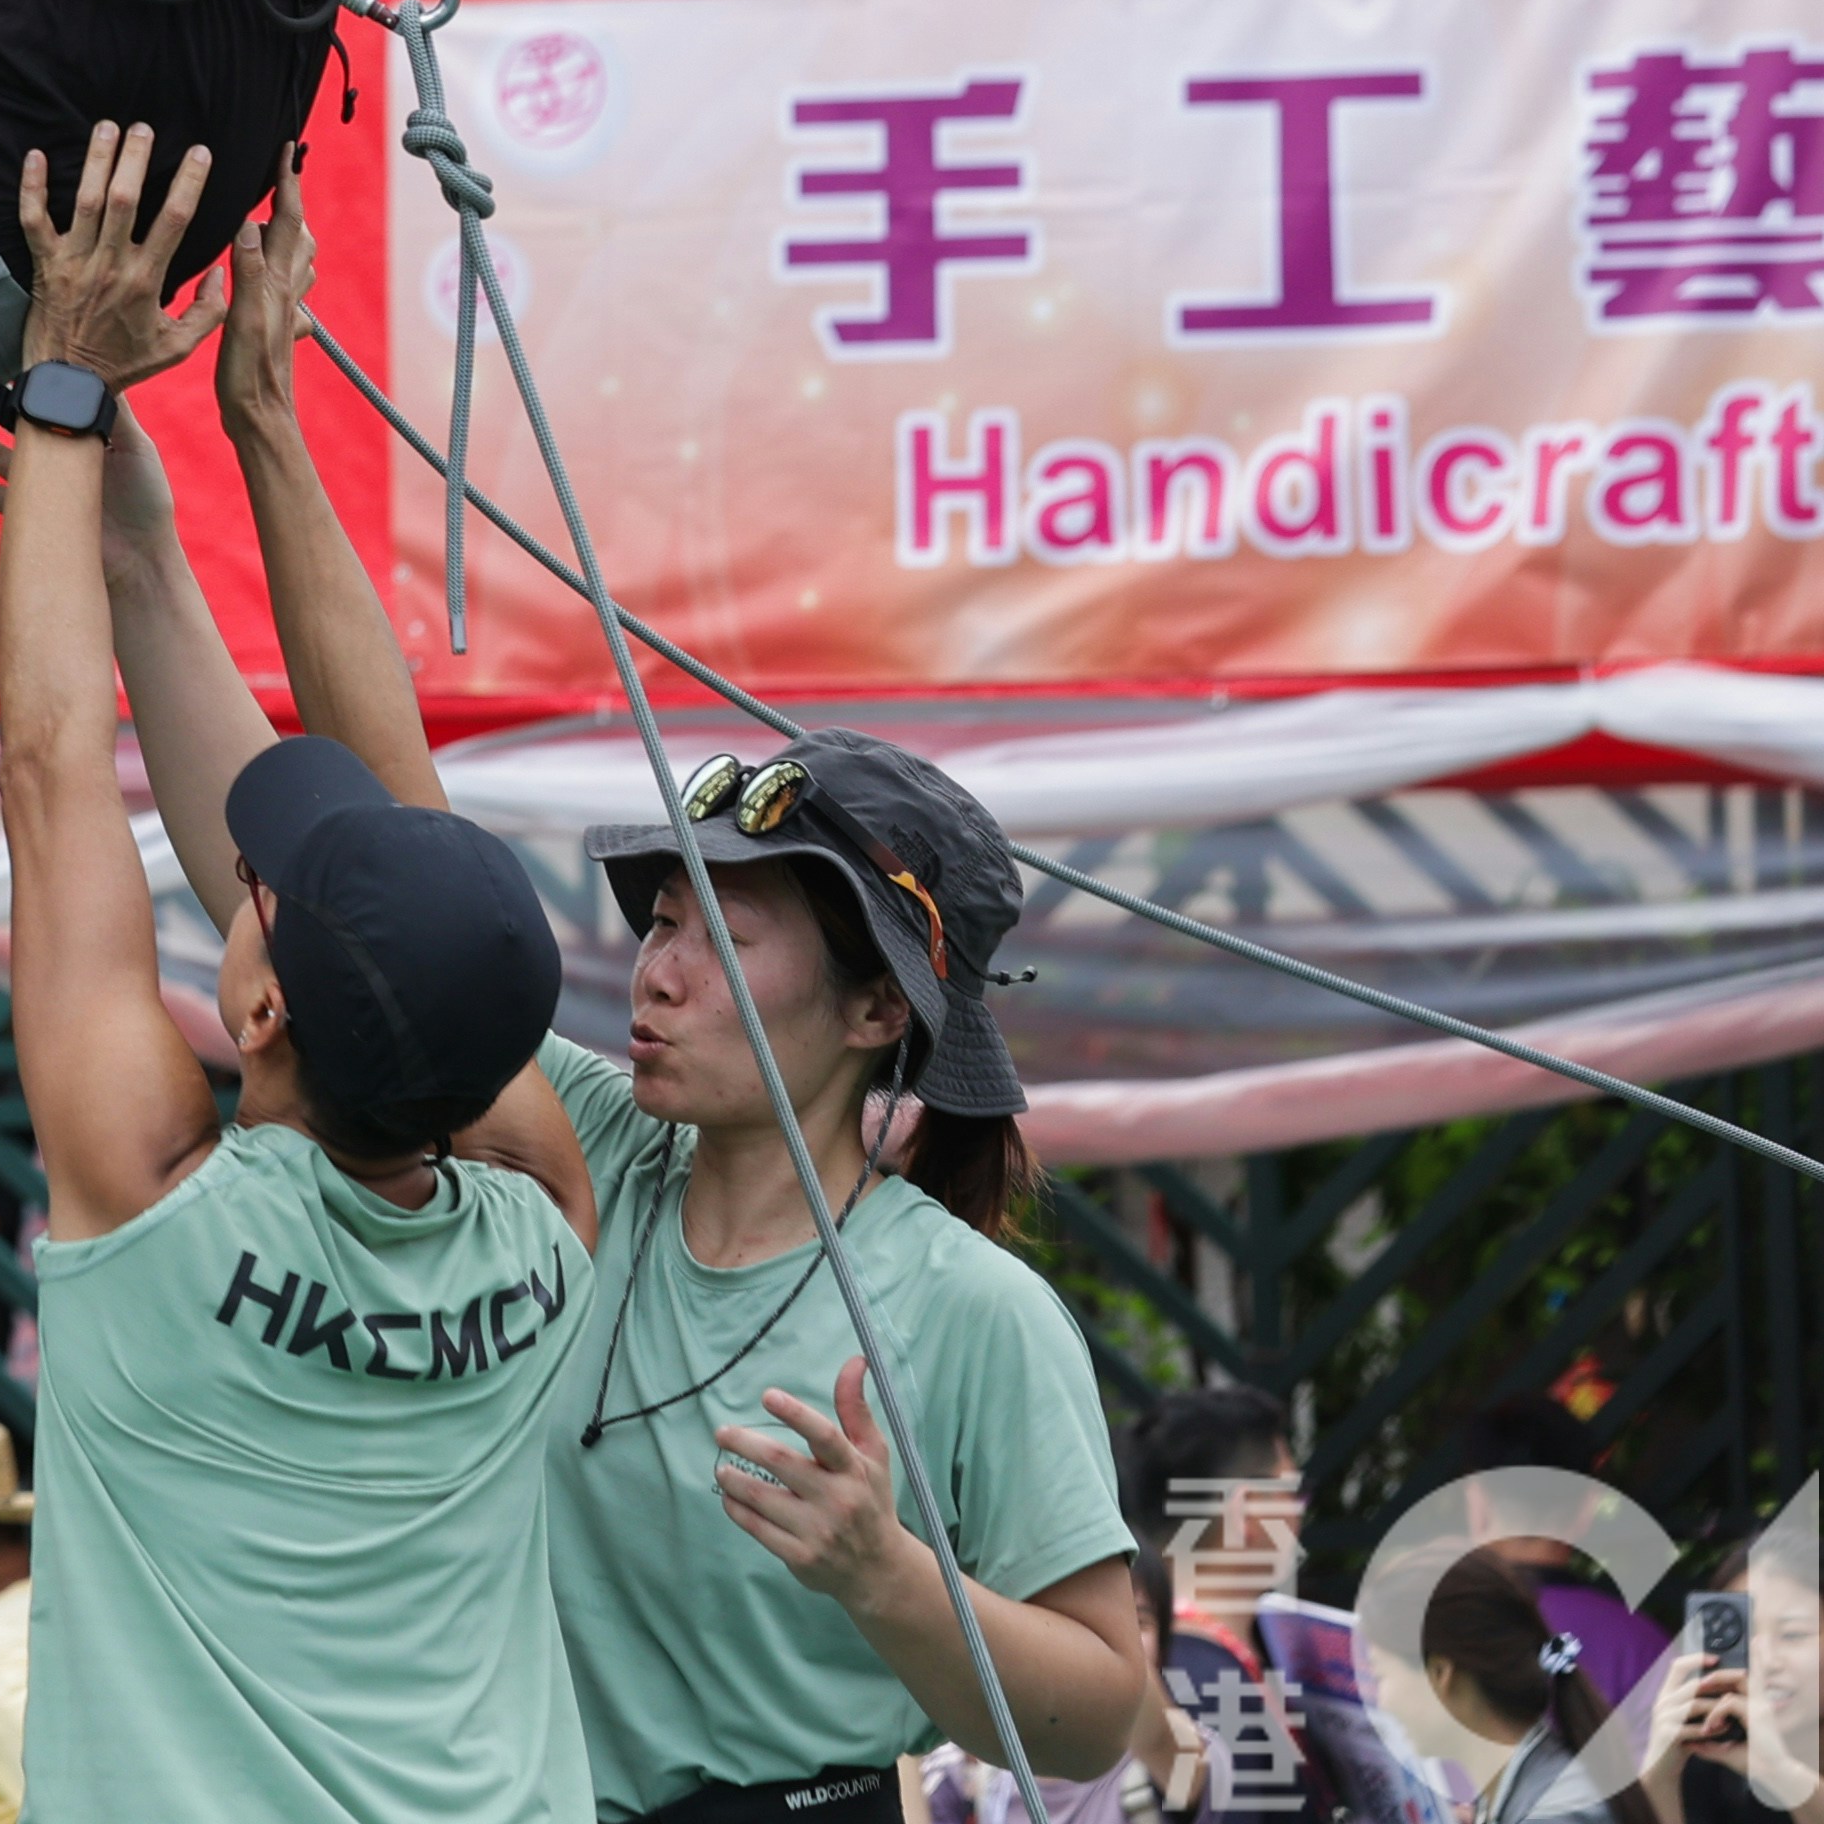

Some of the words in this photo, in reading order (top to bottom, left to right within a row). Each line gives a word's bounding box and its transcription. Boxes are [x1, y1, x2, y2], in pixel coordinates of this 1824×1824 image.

[784, 49, 1824, 344] 手工藝
[908, 397, 1817, 553] Handicraft
